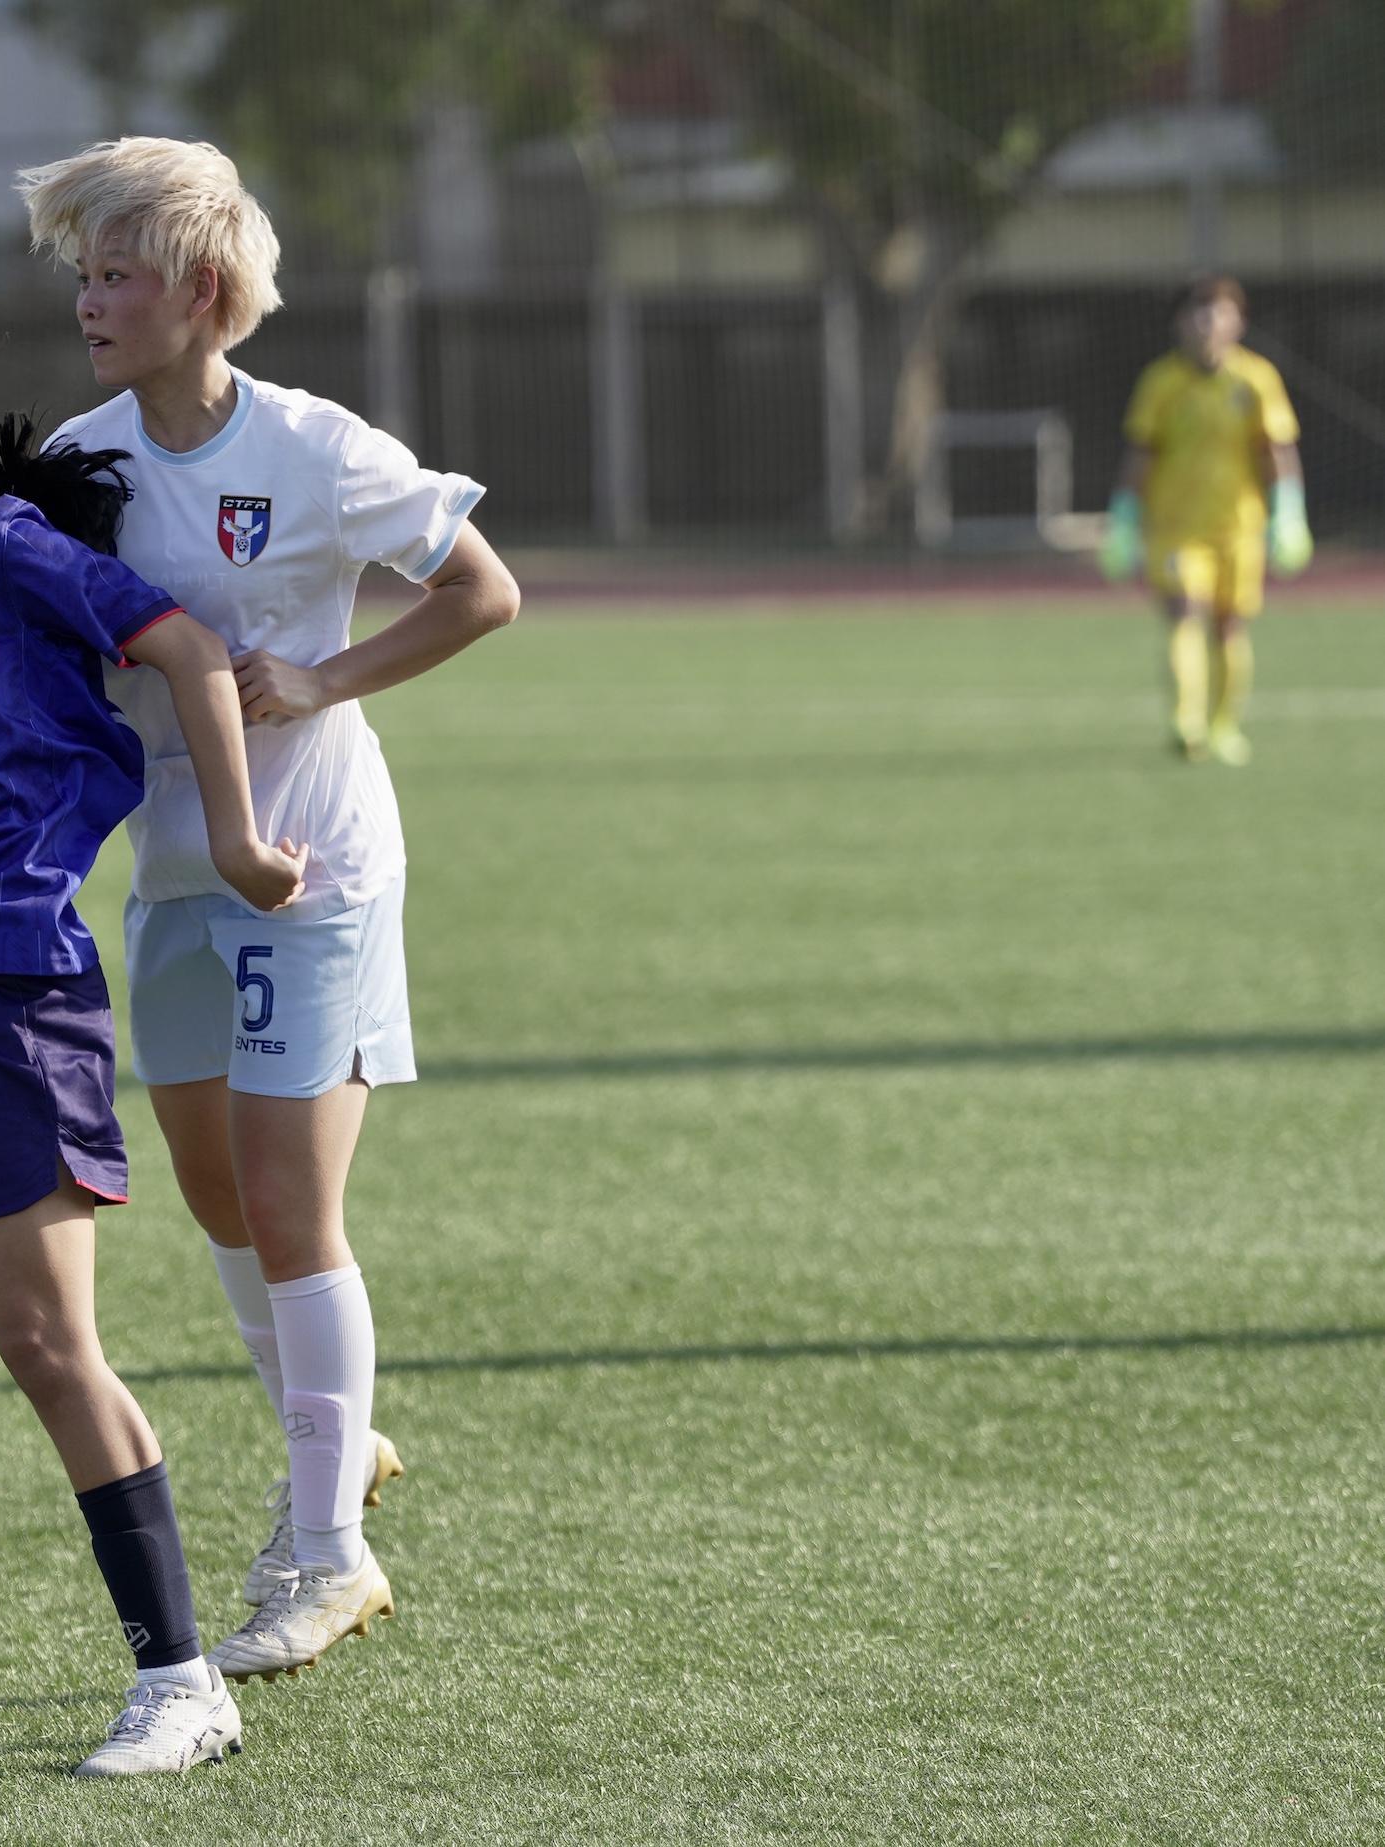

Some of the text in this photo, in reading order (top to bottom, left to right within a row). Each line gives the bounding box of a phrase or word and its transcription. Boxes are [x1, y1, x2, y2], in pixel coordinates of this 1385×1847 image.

[222, 499, 268, 511] CTFA
[236, 945, 274, 1033] 5
[235, 1035, 287, 1055] ENTES
